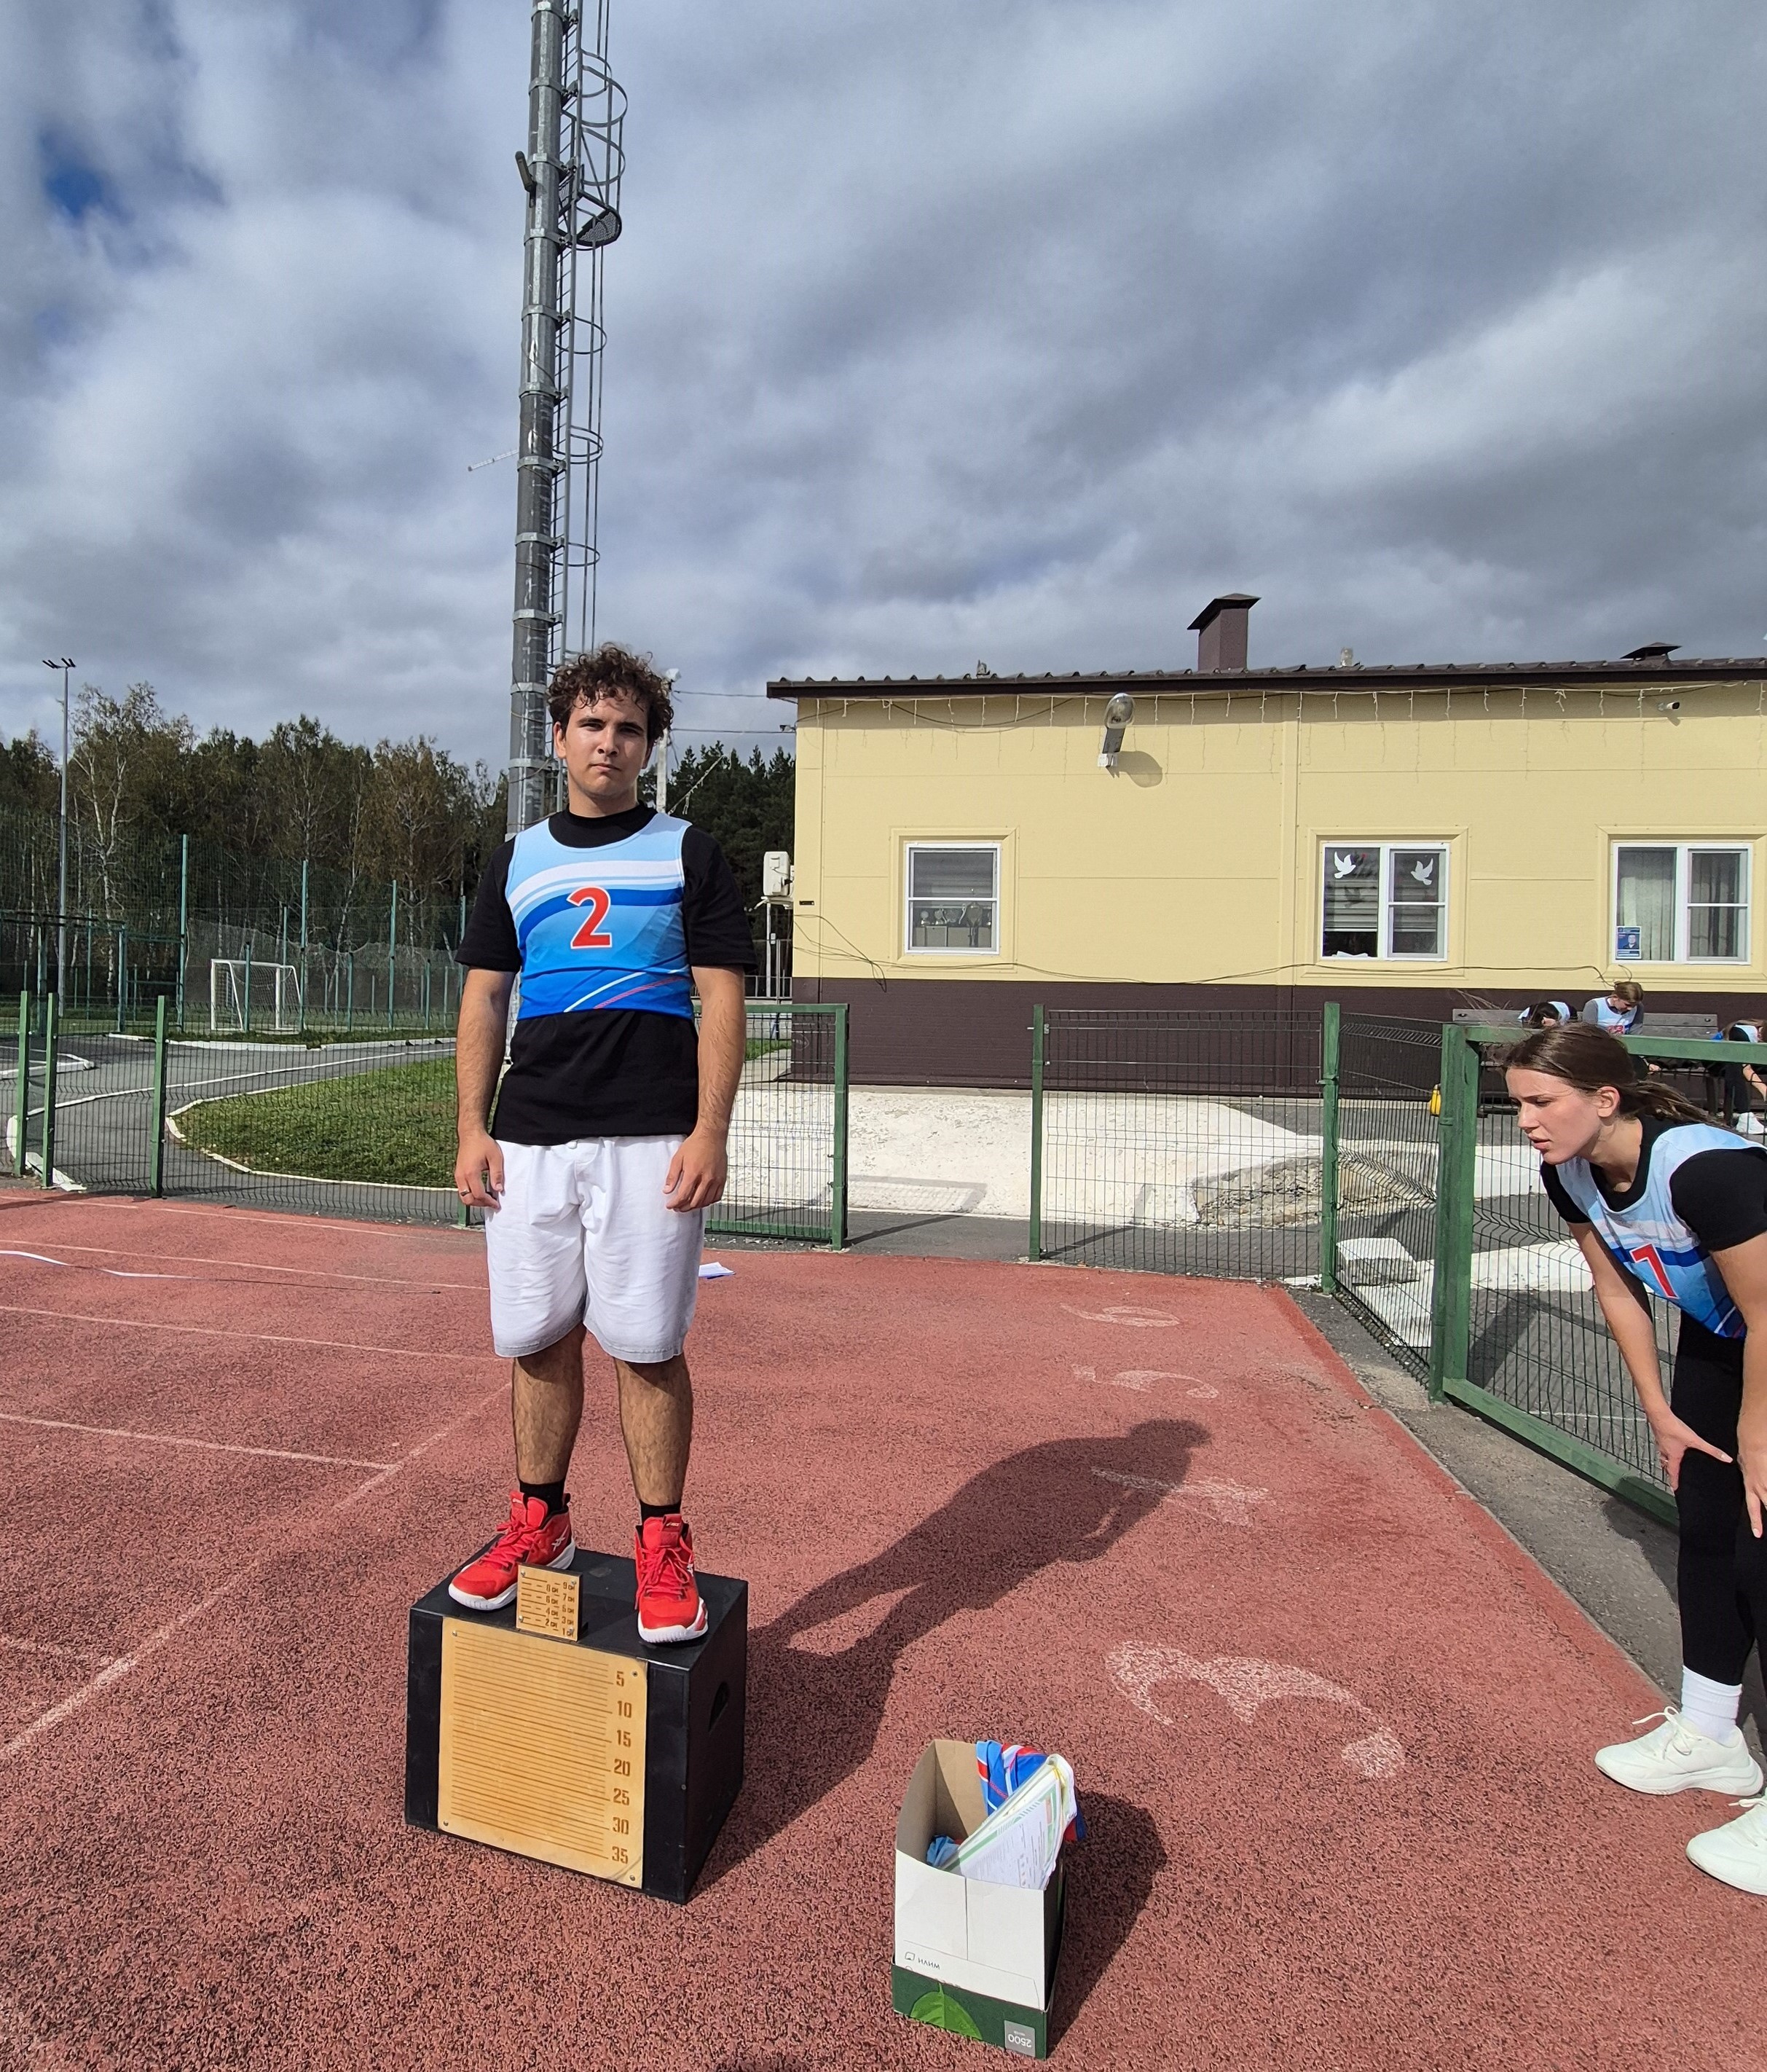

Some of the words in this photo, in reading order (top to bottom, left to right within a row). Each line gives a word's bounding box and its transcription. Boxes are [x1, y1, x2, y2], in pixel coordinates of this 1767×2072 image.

[566, 886, 612, 949] 2
[615, 1671, 625, 1687] 5
[617, 1700, 632, 1719] 10
[1104, 1638, 1406, 1780] 3
[616, 1729, 631, 1748] 15
[613, 1758, 631, 1777] 20
[613, 1787, 630, 1806] 25
[613, 1816, 629, 1835] 30
[612, 1845, 629, 1864] 35
[1007, 2033, 1032, 2048] 2500
